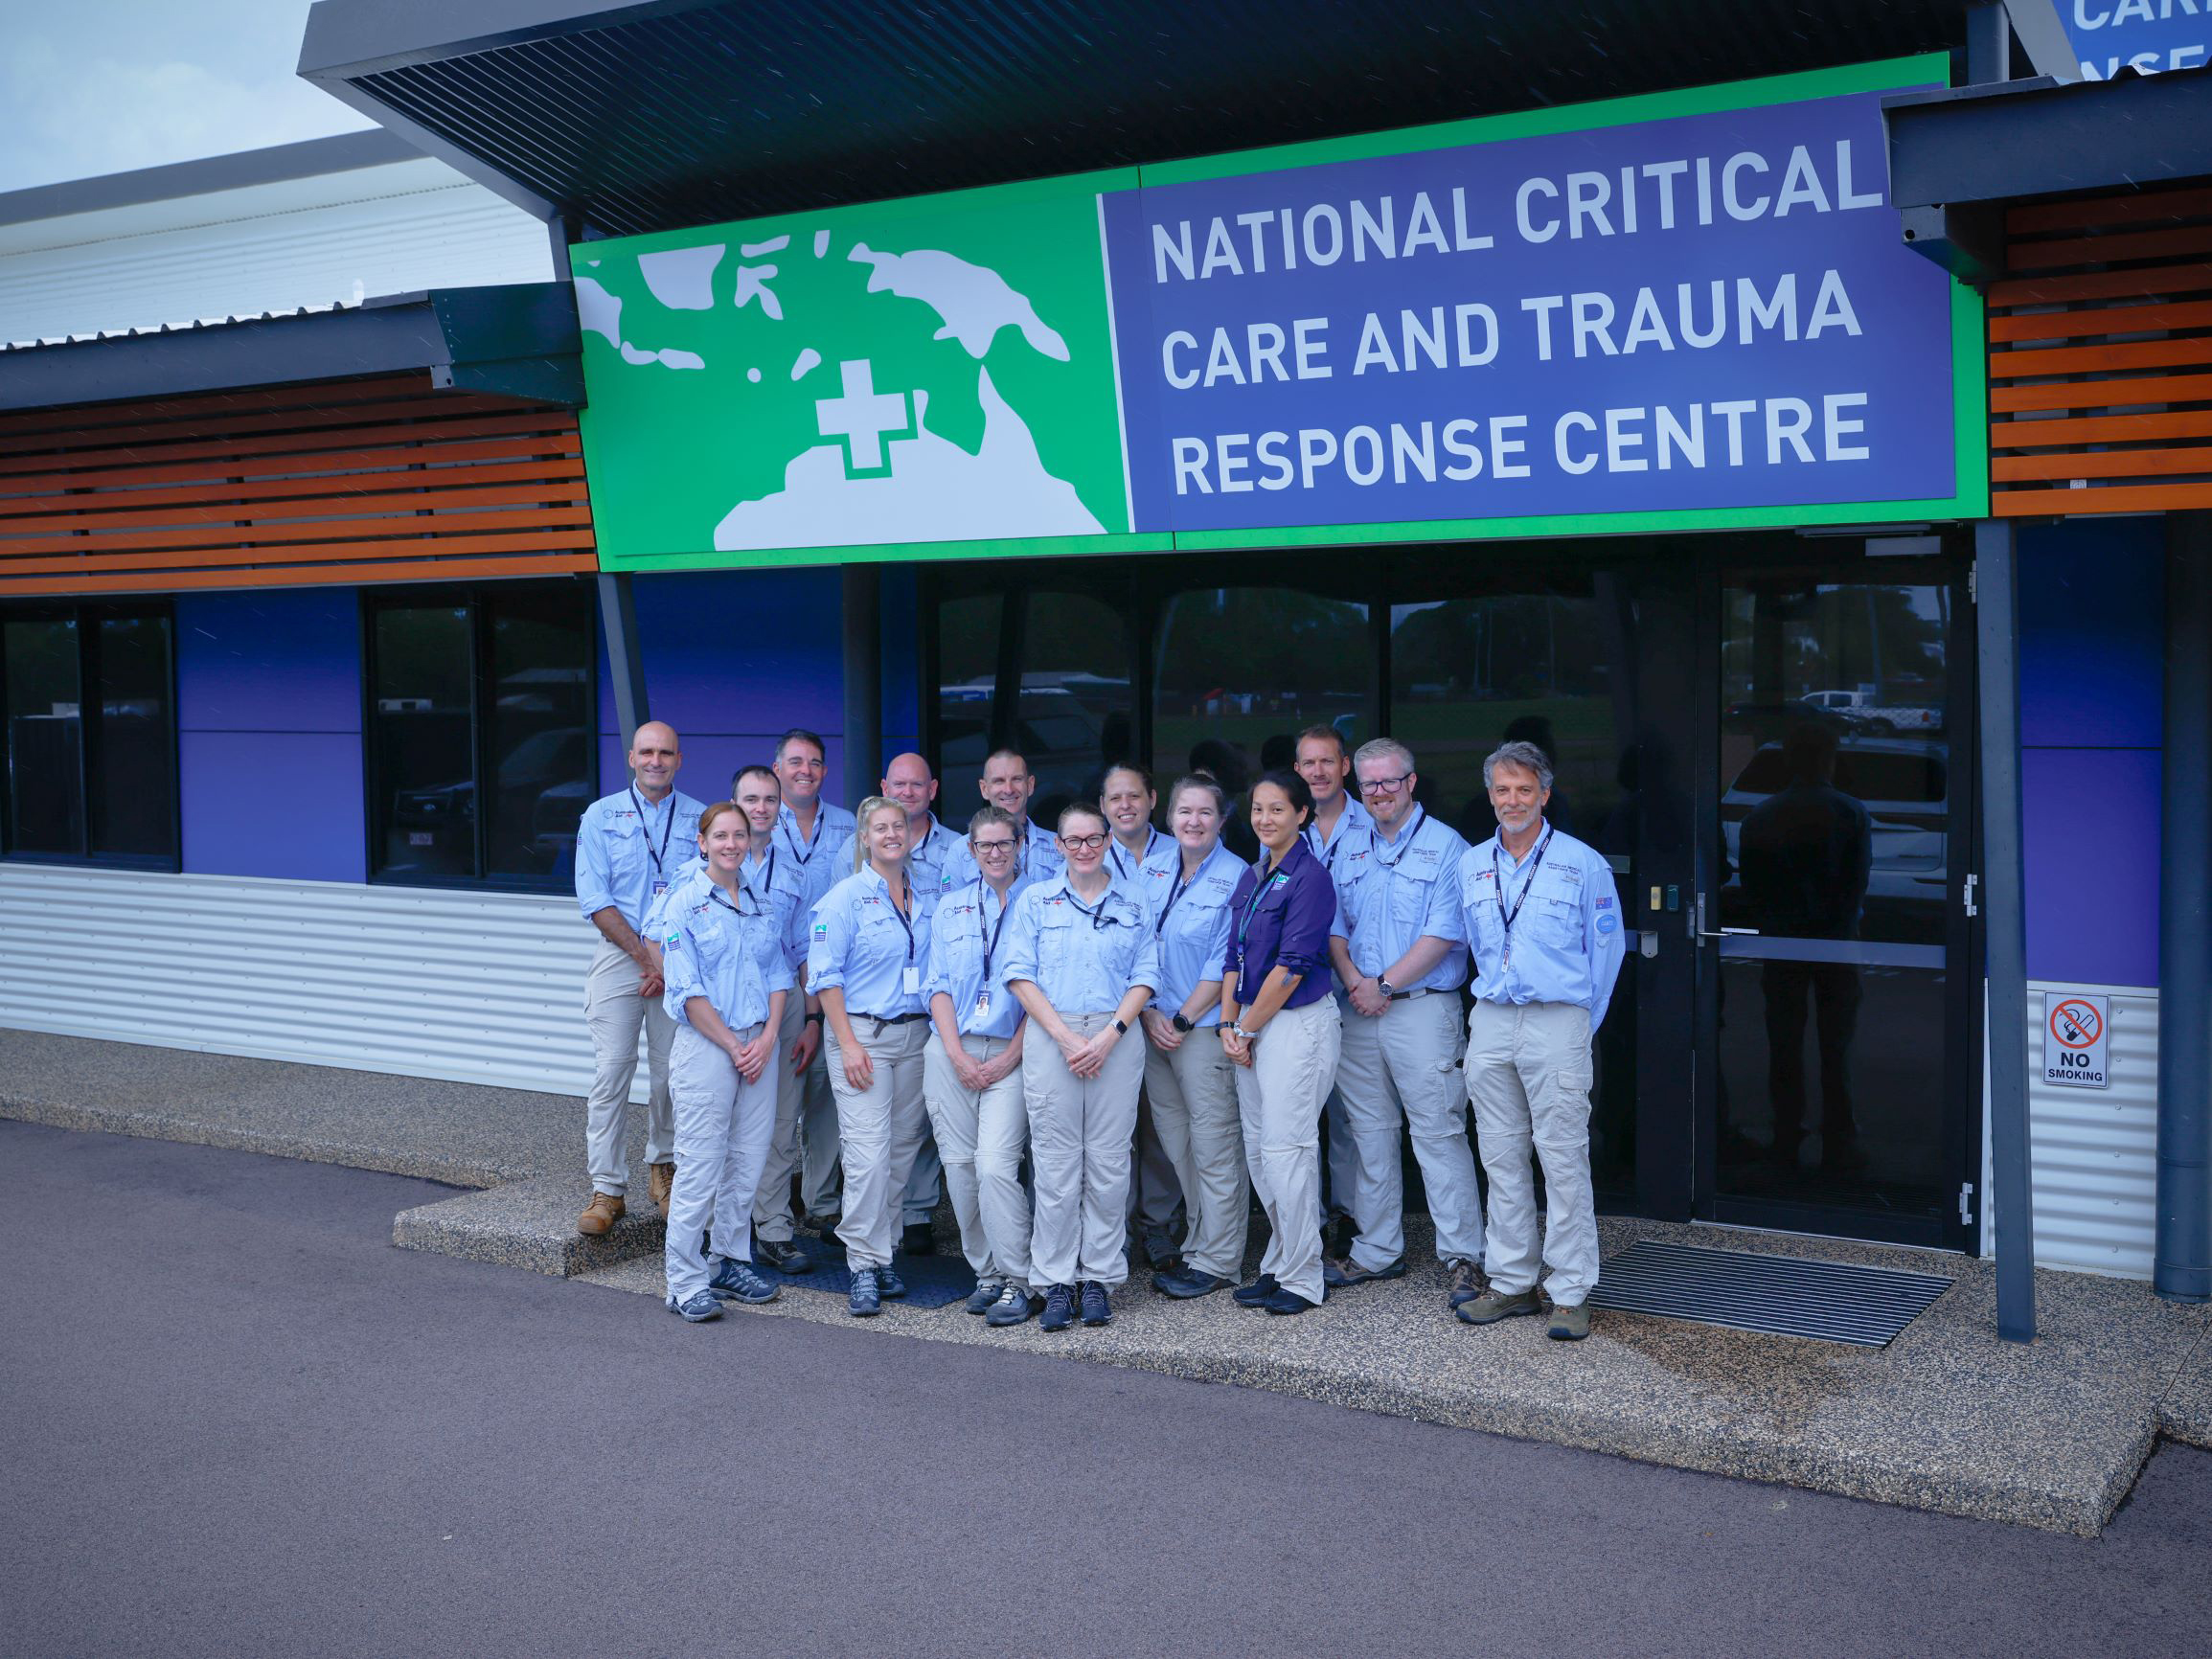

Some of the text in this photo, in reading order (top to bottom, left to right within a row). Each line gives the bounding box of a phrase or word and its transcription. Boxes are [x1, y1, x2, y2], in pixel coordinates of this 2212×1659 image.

[1152, 139, 1884, 284] NATIONAL CRITICAL
[1161, 268, 1864, 391] CARE AND TRAUMA
[1172, 392, 1871, 496] RESPONSE CENTRE
[2048, 1068, 2103, 1081] SMOKING
[2061, 1052, 2090, 1068] NO
